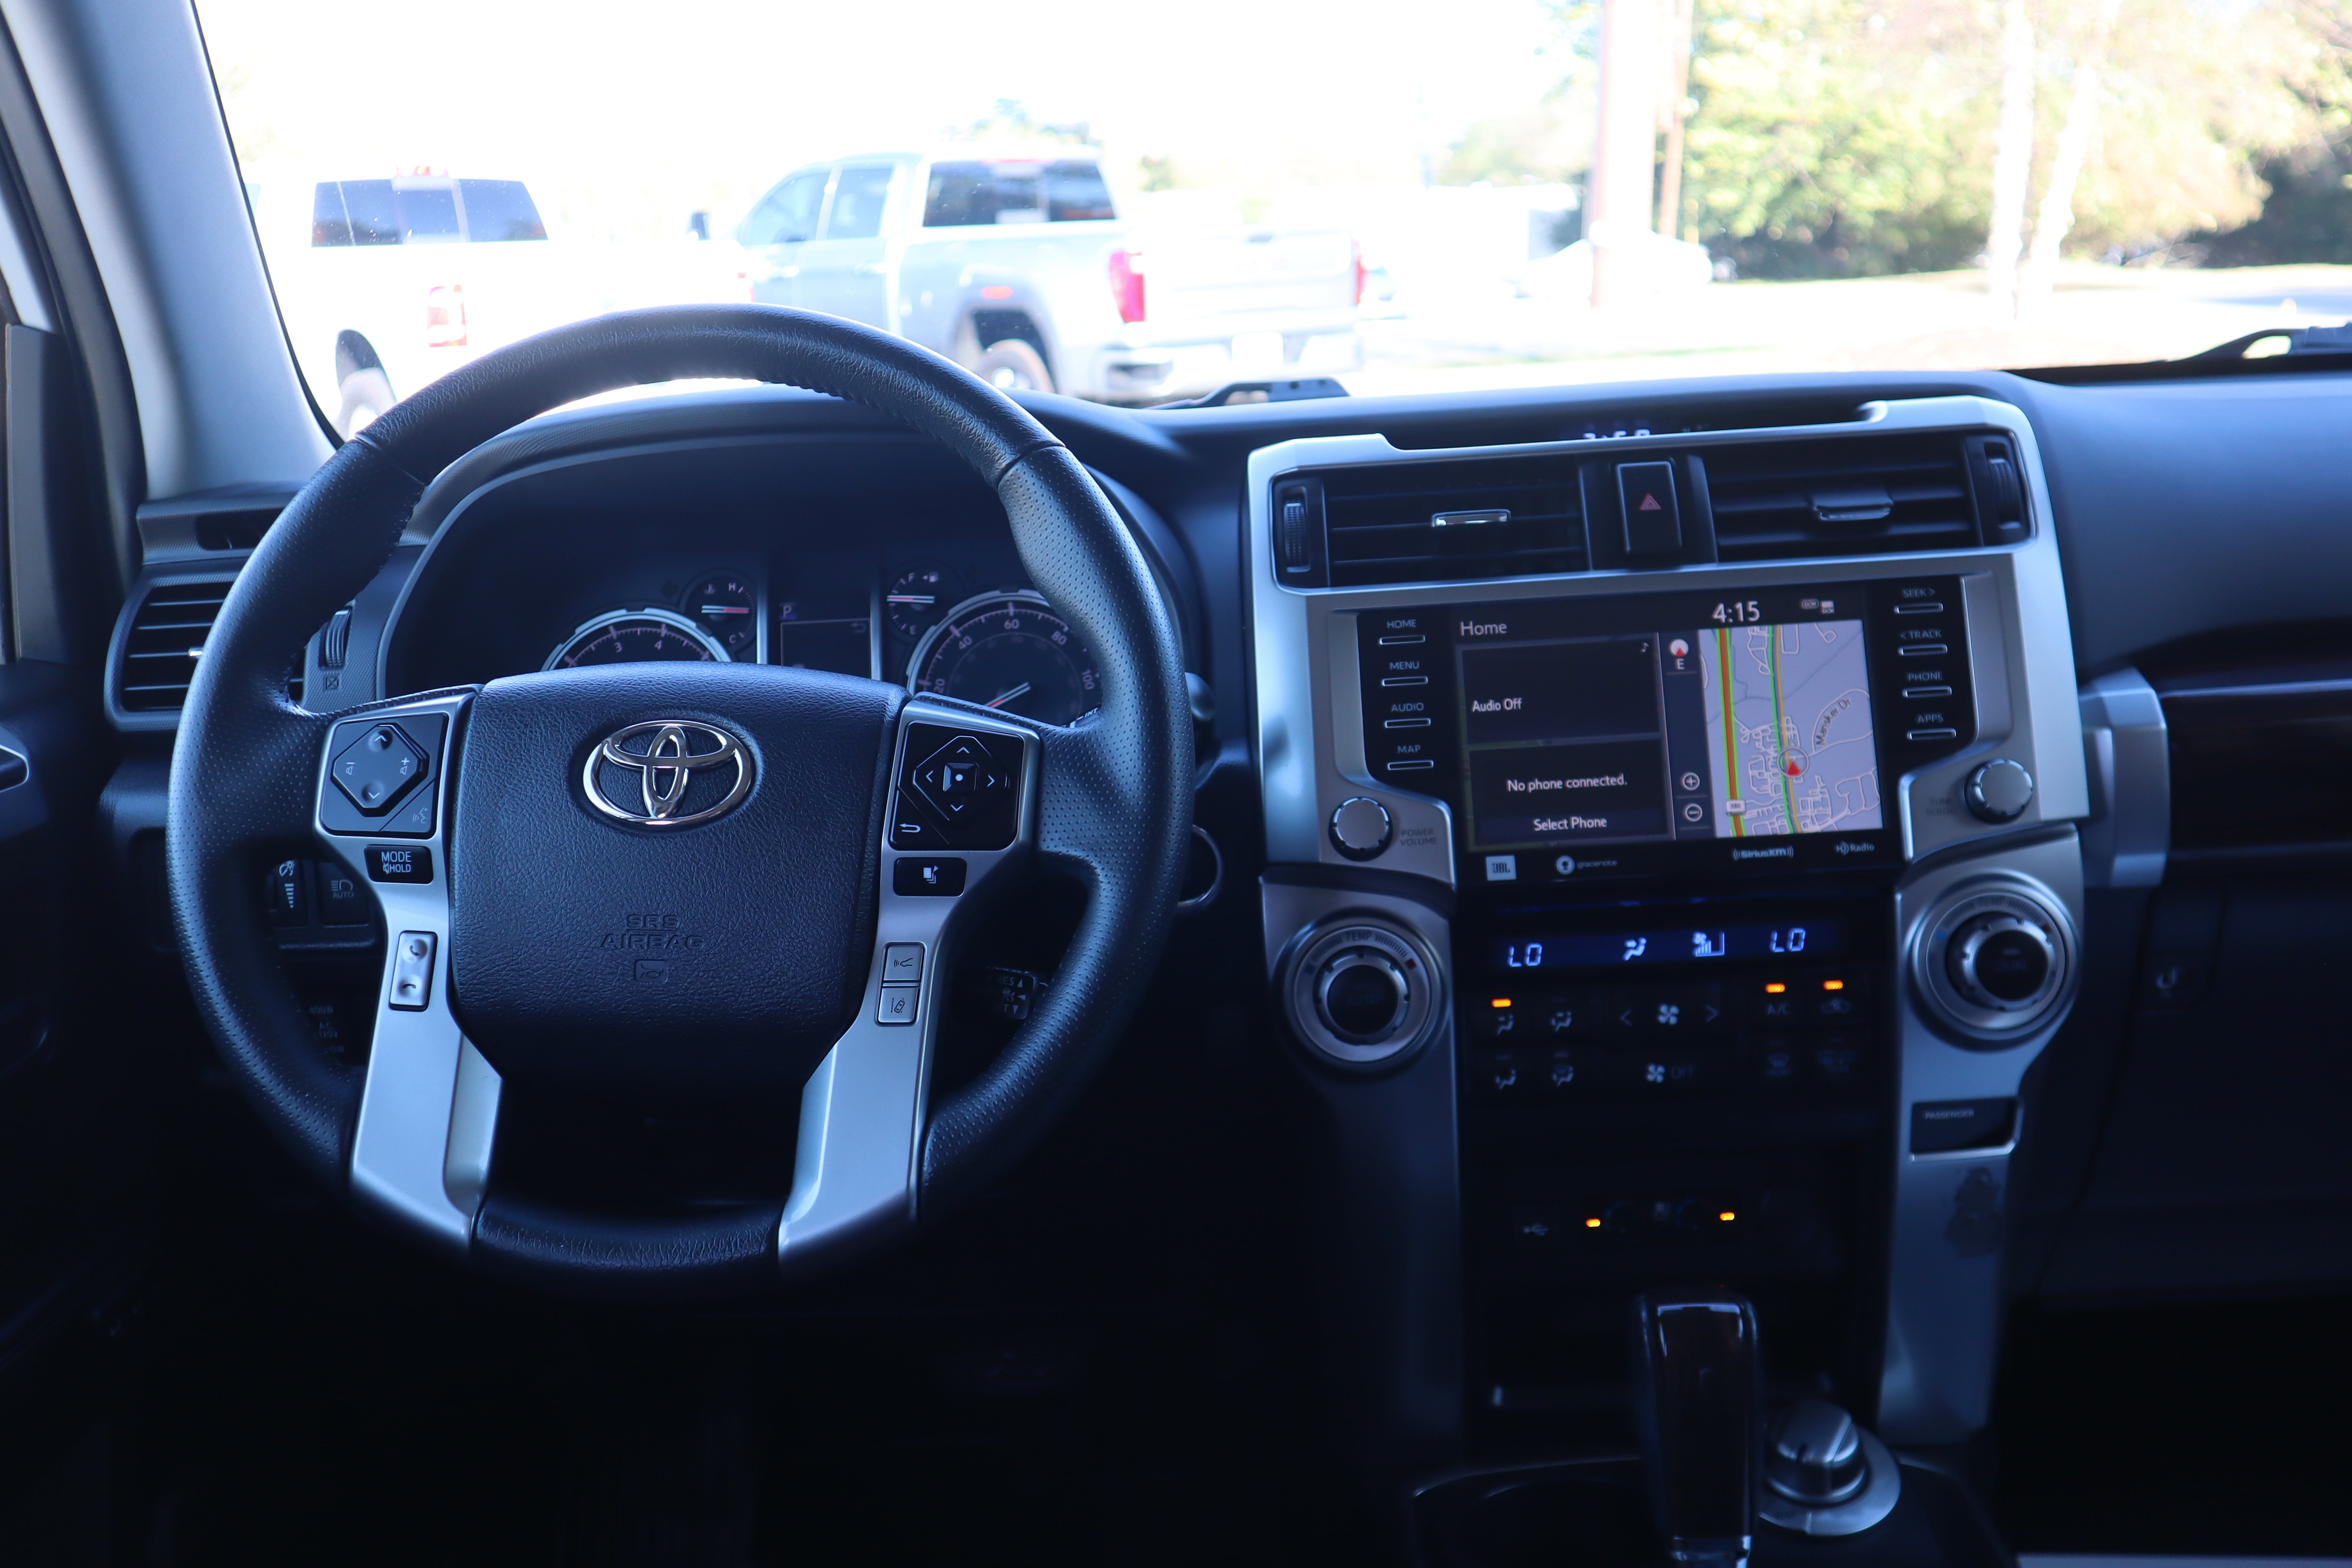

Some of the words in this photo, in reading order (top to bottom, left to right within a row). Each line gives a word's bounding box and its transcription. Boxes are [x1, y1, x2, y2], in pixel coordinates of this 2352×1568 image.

[908, 573, 915, 582] F
[728, 582, 737, 591] H
[1712, 601, 1760, 623] 4:15
[1004, 619, 1020, 629] 60
[1387, 619, 1417, 628] HOME
[1460, 621, 1508, 636] Home
[910, 626, 916, 635] E
[1910, 629, 1942, 639] TRACK
[729, 634, 737, 644] C
[958, 635, 973, 650] 40
[1051, 630, 1067, 646] 80
[613, 643, 623, 653] 3
[654, 640, 662, 650] 4
[1390, 661, 1420, 670] MENU
[1676, 659, 1685, 670] E
[1081, 669, 1095, 690] 100
[1907, 672, 1943, 682] PHONE
[1391, 702, 1424, 712] AUDIO
[1472, 700, 1501, 712] Audio
[1504, 698, 1522, 710] Off
[1084, 707, 1099, 718] INT
[1816, 710, 1839, 745] Mansker
[1837, 698, 1852, 716] Dr
[1918, 714, 1944, 724] APPS
[1397, 744, 1421, 753] MAP
[1507, 780, 1526, 792] No
[1528, 779, 1564, 793] phone
[1566, 774, 1628, 789] connected.
[1534, 819, 1568, 831] Select
[1571, 817, 1607, 829] Phone
[1401, 828, 1434, 837] POWER
[1400, 837, 1437, 846] VOLUME
[1850, 842, 1875, 852] Radio
[381, 851, 411, 862] MODE
[390, 863, 411, 873] HOLD
[1492, 862, 1511, 873] JBL
[626, 914, 679, 928] SRS
[1345, 931, 1372, 941] TEMP
[1770, 928, 1806, 952] LO
[601, 935, 704, 950] AIRBAG
[1508, 943, 1542, 967] LO
[1767, 1002, 1791, 1015] A/C
[1924, 1108, 1975, 1120] PASSENGER
